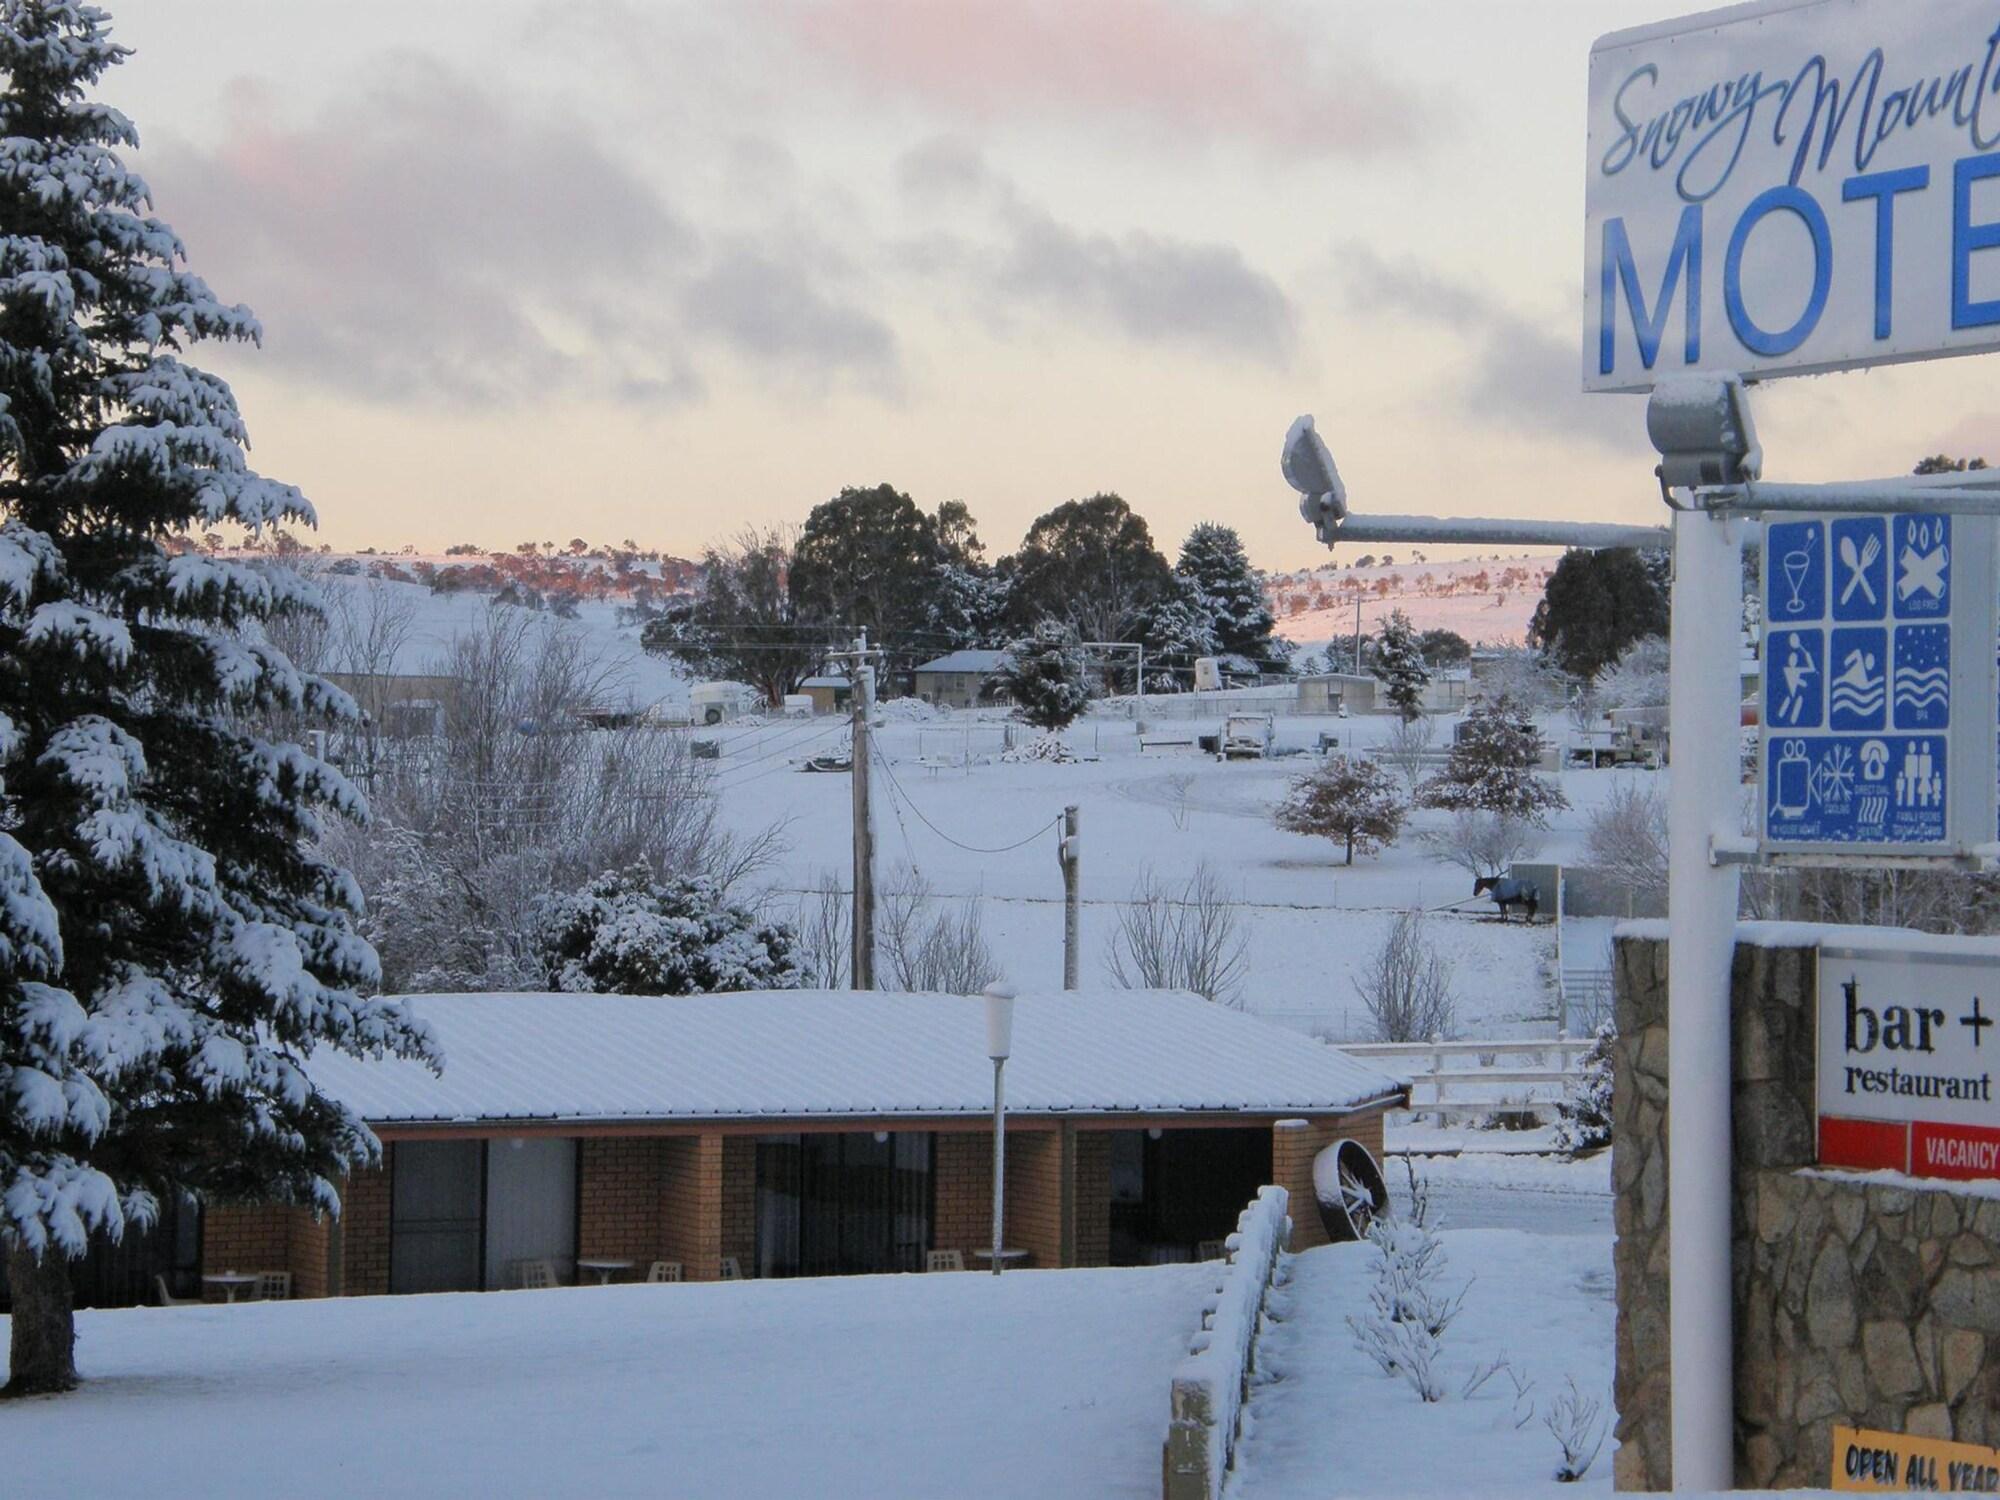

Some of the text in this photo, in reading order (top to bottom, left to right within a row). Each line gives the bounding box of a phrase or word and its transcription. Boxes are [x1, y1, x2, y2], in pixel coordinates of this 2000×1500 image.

[1602, 20, 2000, 203] Snowy Mount
[1841, 974, 1993, 1053] bar +
[1844, 1066, 1991, 1101] restaurant
[1925, 1136, 2000, 1170] VACANCY
[1846, 1444, 2000, 1492] OPEN ALL YEAR
